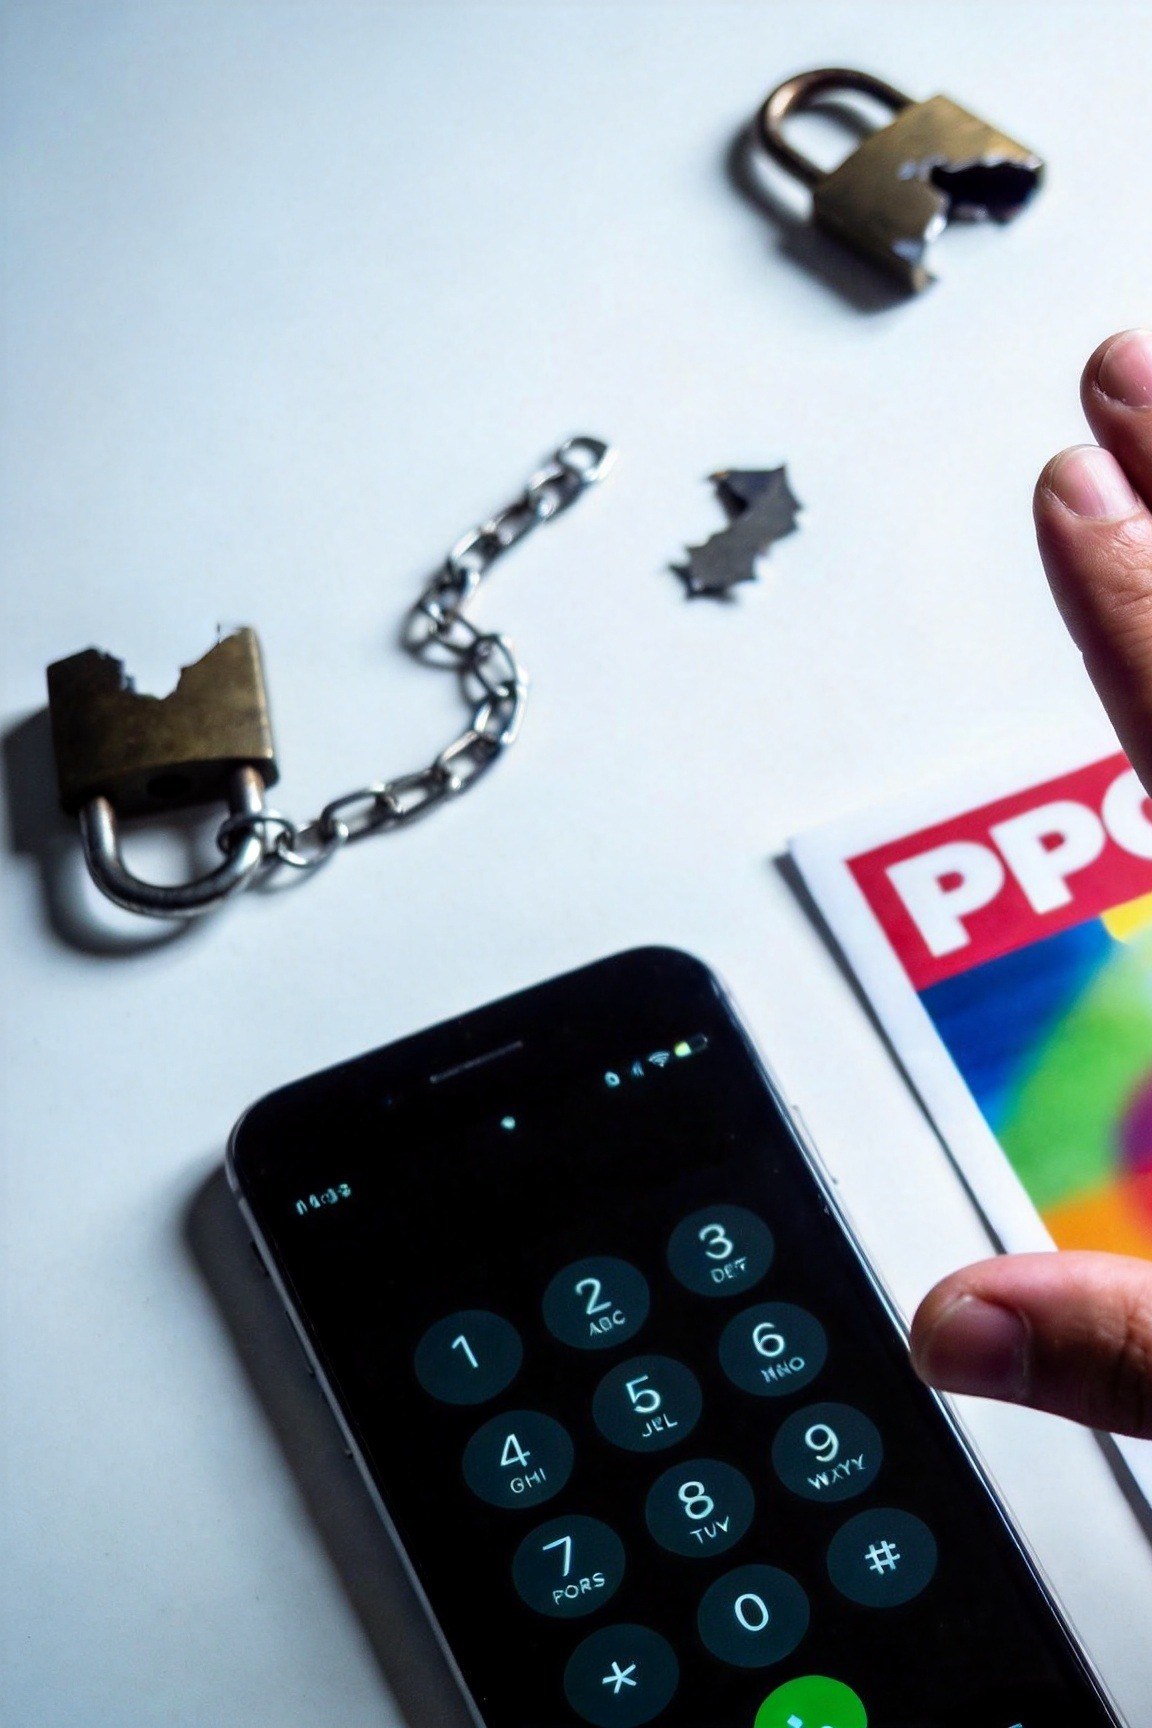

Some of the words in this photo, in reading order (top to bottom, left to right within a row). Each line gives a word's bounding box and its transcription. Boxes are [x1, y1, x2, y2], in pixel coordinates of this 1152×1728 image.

[698, 1223, 734, 1260] 3
[575, 1277, 612, 1315] 2
[451, 1334, 479, 1368] 1
[752, 1321, 785, 1357] 6
[625, 1374, 661, 1414] 5
[500, 1433, 531, 1467] 4
[804, 1423, 839, 1462] 9
[509, 1467, 547, 1494] GHI
[677, 1480, 715, 1520] 8
[689, 1516, 730, 1544] TUV
[542, 1535, 572, 1577] 7
